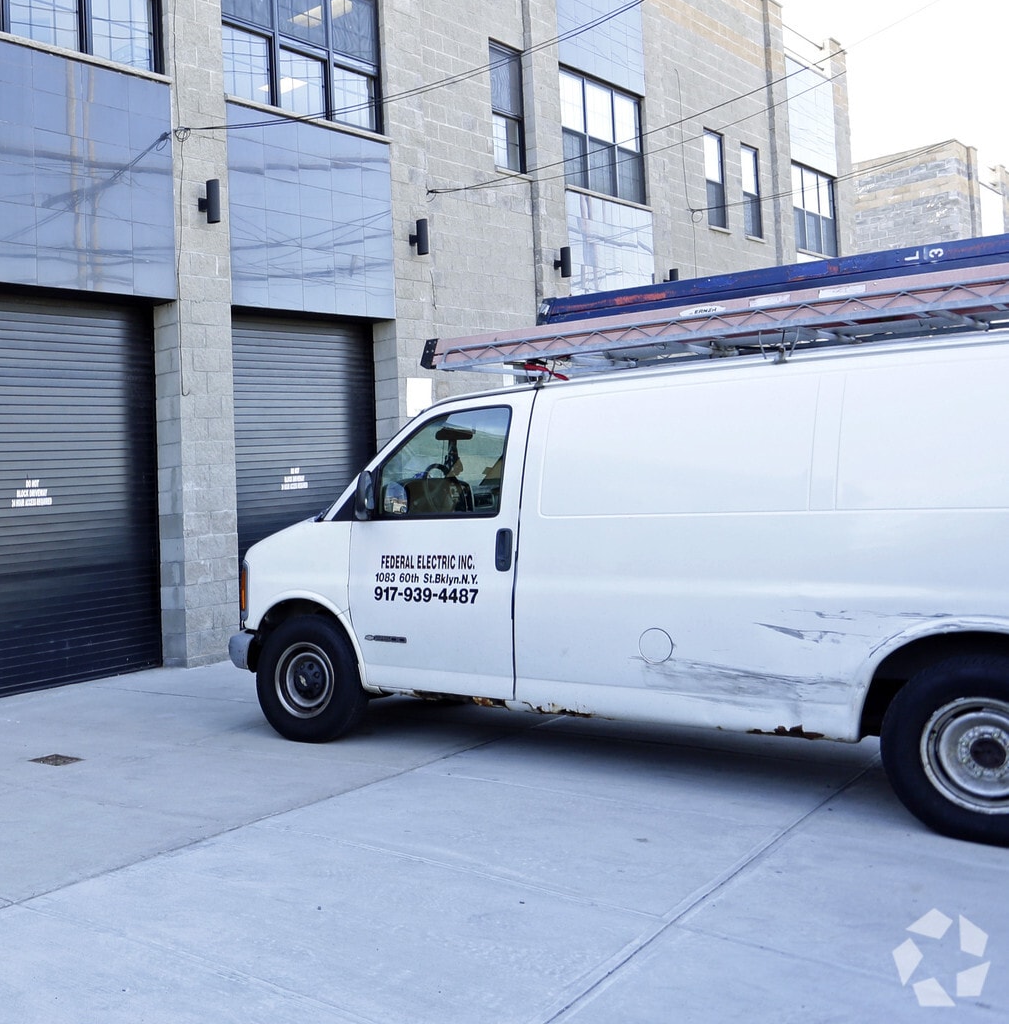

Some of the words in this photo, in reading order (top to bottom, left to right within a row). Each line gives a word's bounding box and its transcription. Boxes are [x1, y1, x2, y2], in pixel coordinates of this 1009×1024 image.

[380, 555, 415, 570] FEDERAL
[417, 555, 456, 570] ELECTRIC
[458, 555, 475, 570] INC.
[375, 572, 396, 583] 1083
[399, 572, 420, 584] 60th
[374, 586, 479, 604] 917-939-4487
